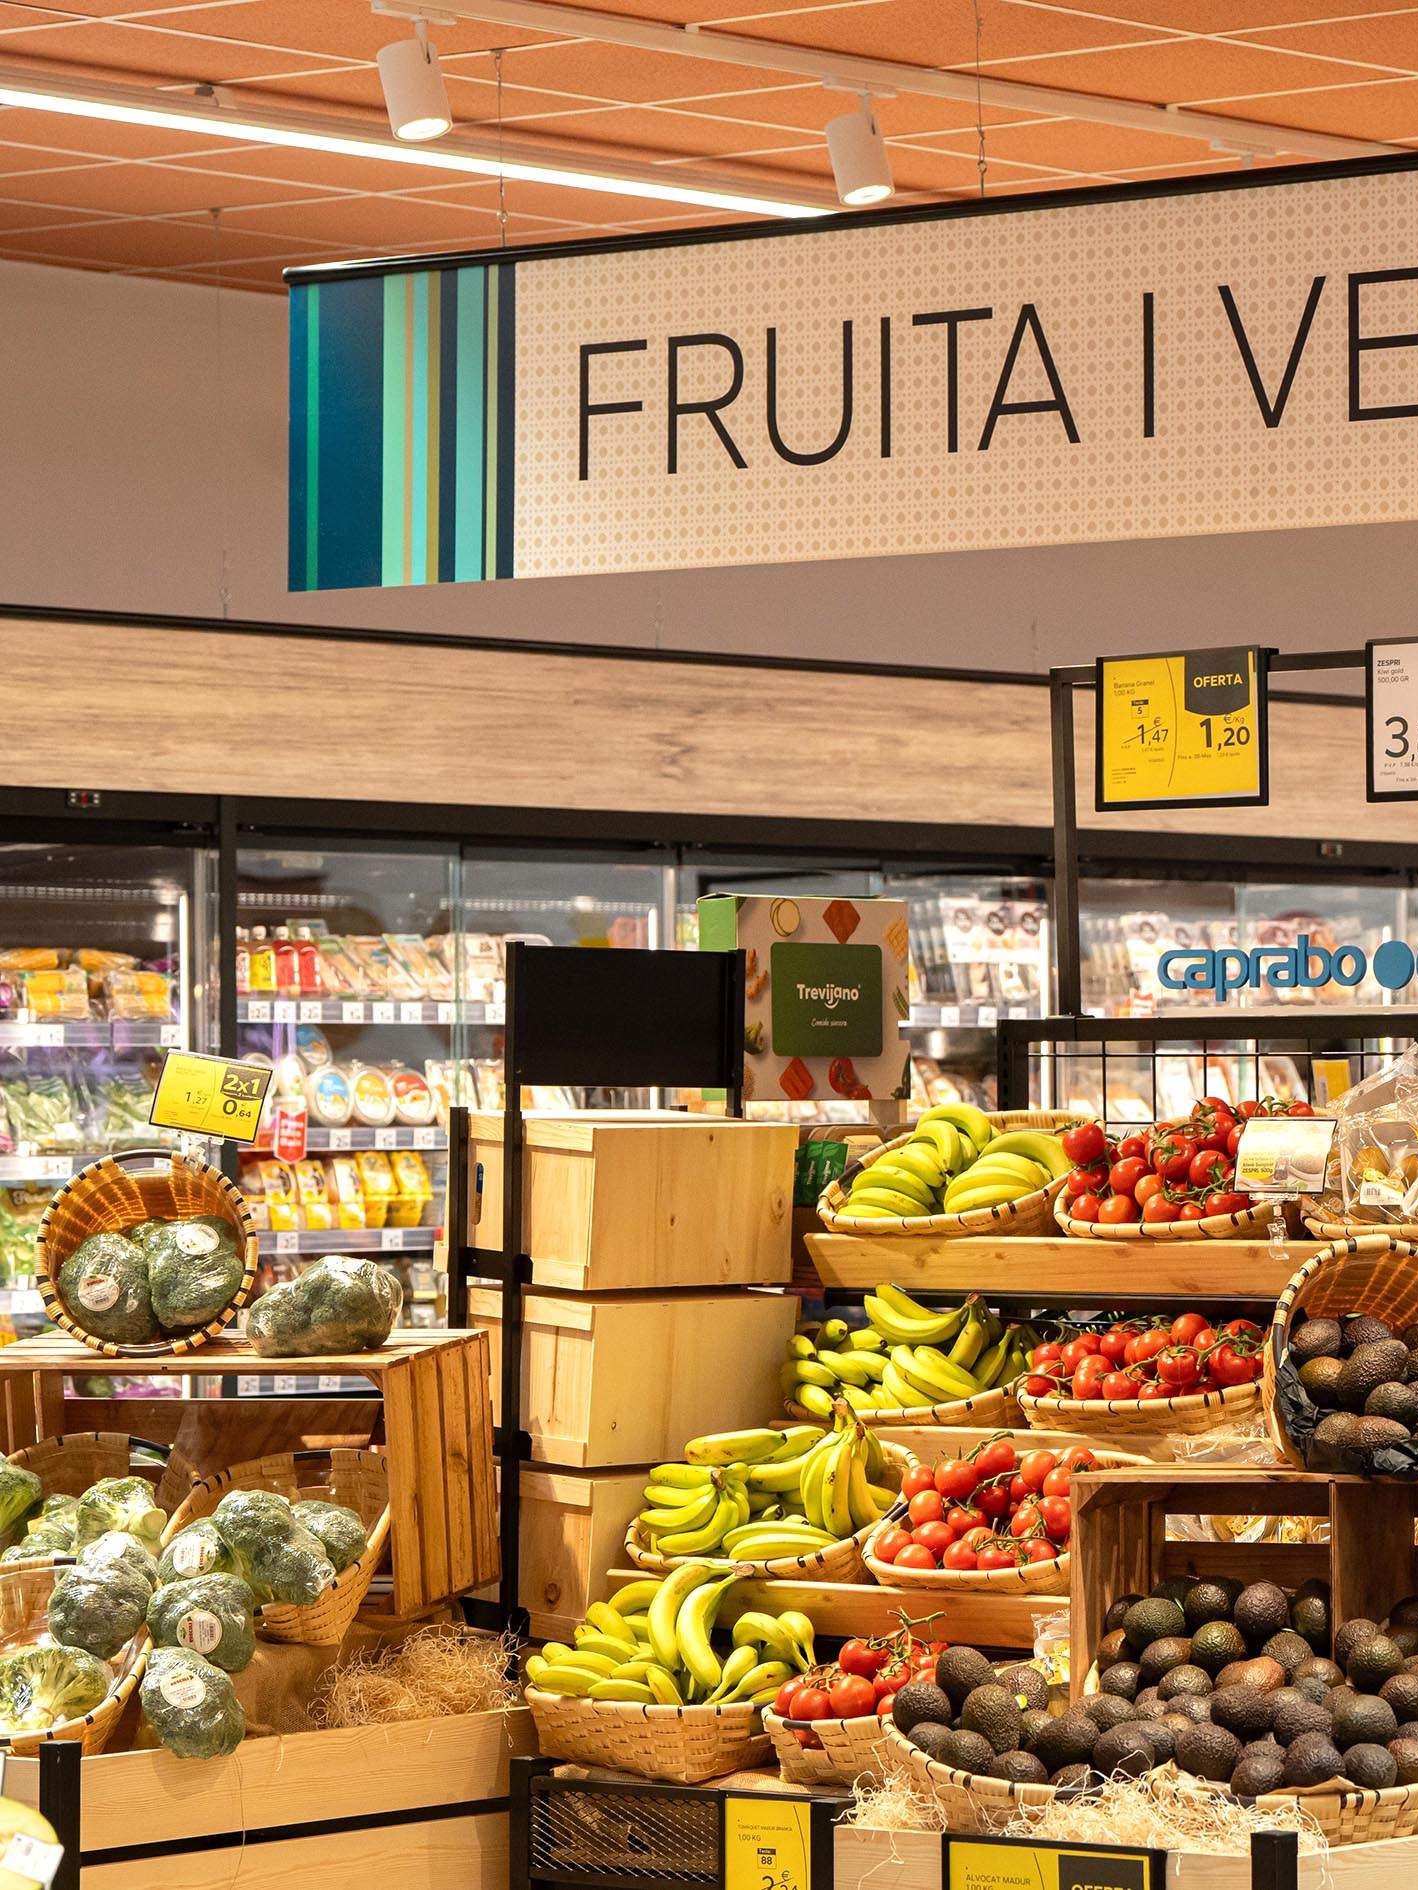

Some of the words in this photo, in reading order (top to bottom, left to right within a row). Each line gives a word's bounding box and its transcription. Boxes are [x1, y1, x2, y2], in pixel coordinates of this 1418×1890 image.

[580, 304, 1080, 480] FRUITA
[1143, 293, 1154, 438] I
[1377, 659, 1401, 667] ZESPRI
[1193, 673, 1243, 688] OFERTA
[1137, 724, 1168, 746] 1,47
[1200, 718, 1250, 751] 1,20
[1158, 934, 1367, 1001] caprabo
[797, 983, 860, 1006] Trevijano
[224, 1074, 261, 1095] 2x1
[752, 1834, 761, 1842] KG
[761, 1856, 773, 1866] 88
[966, 1874, 1000, 1884] ALVOCAT
[1002, 1876, 1031, 1886] MADUR
